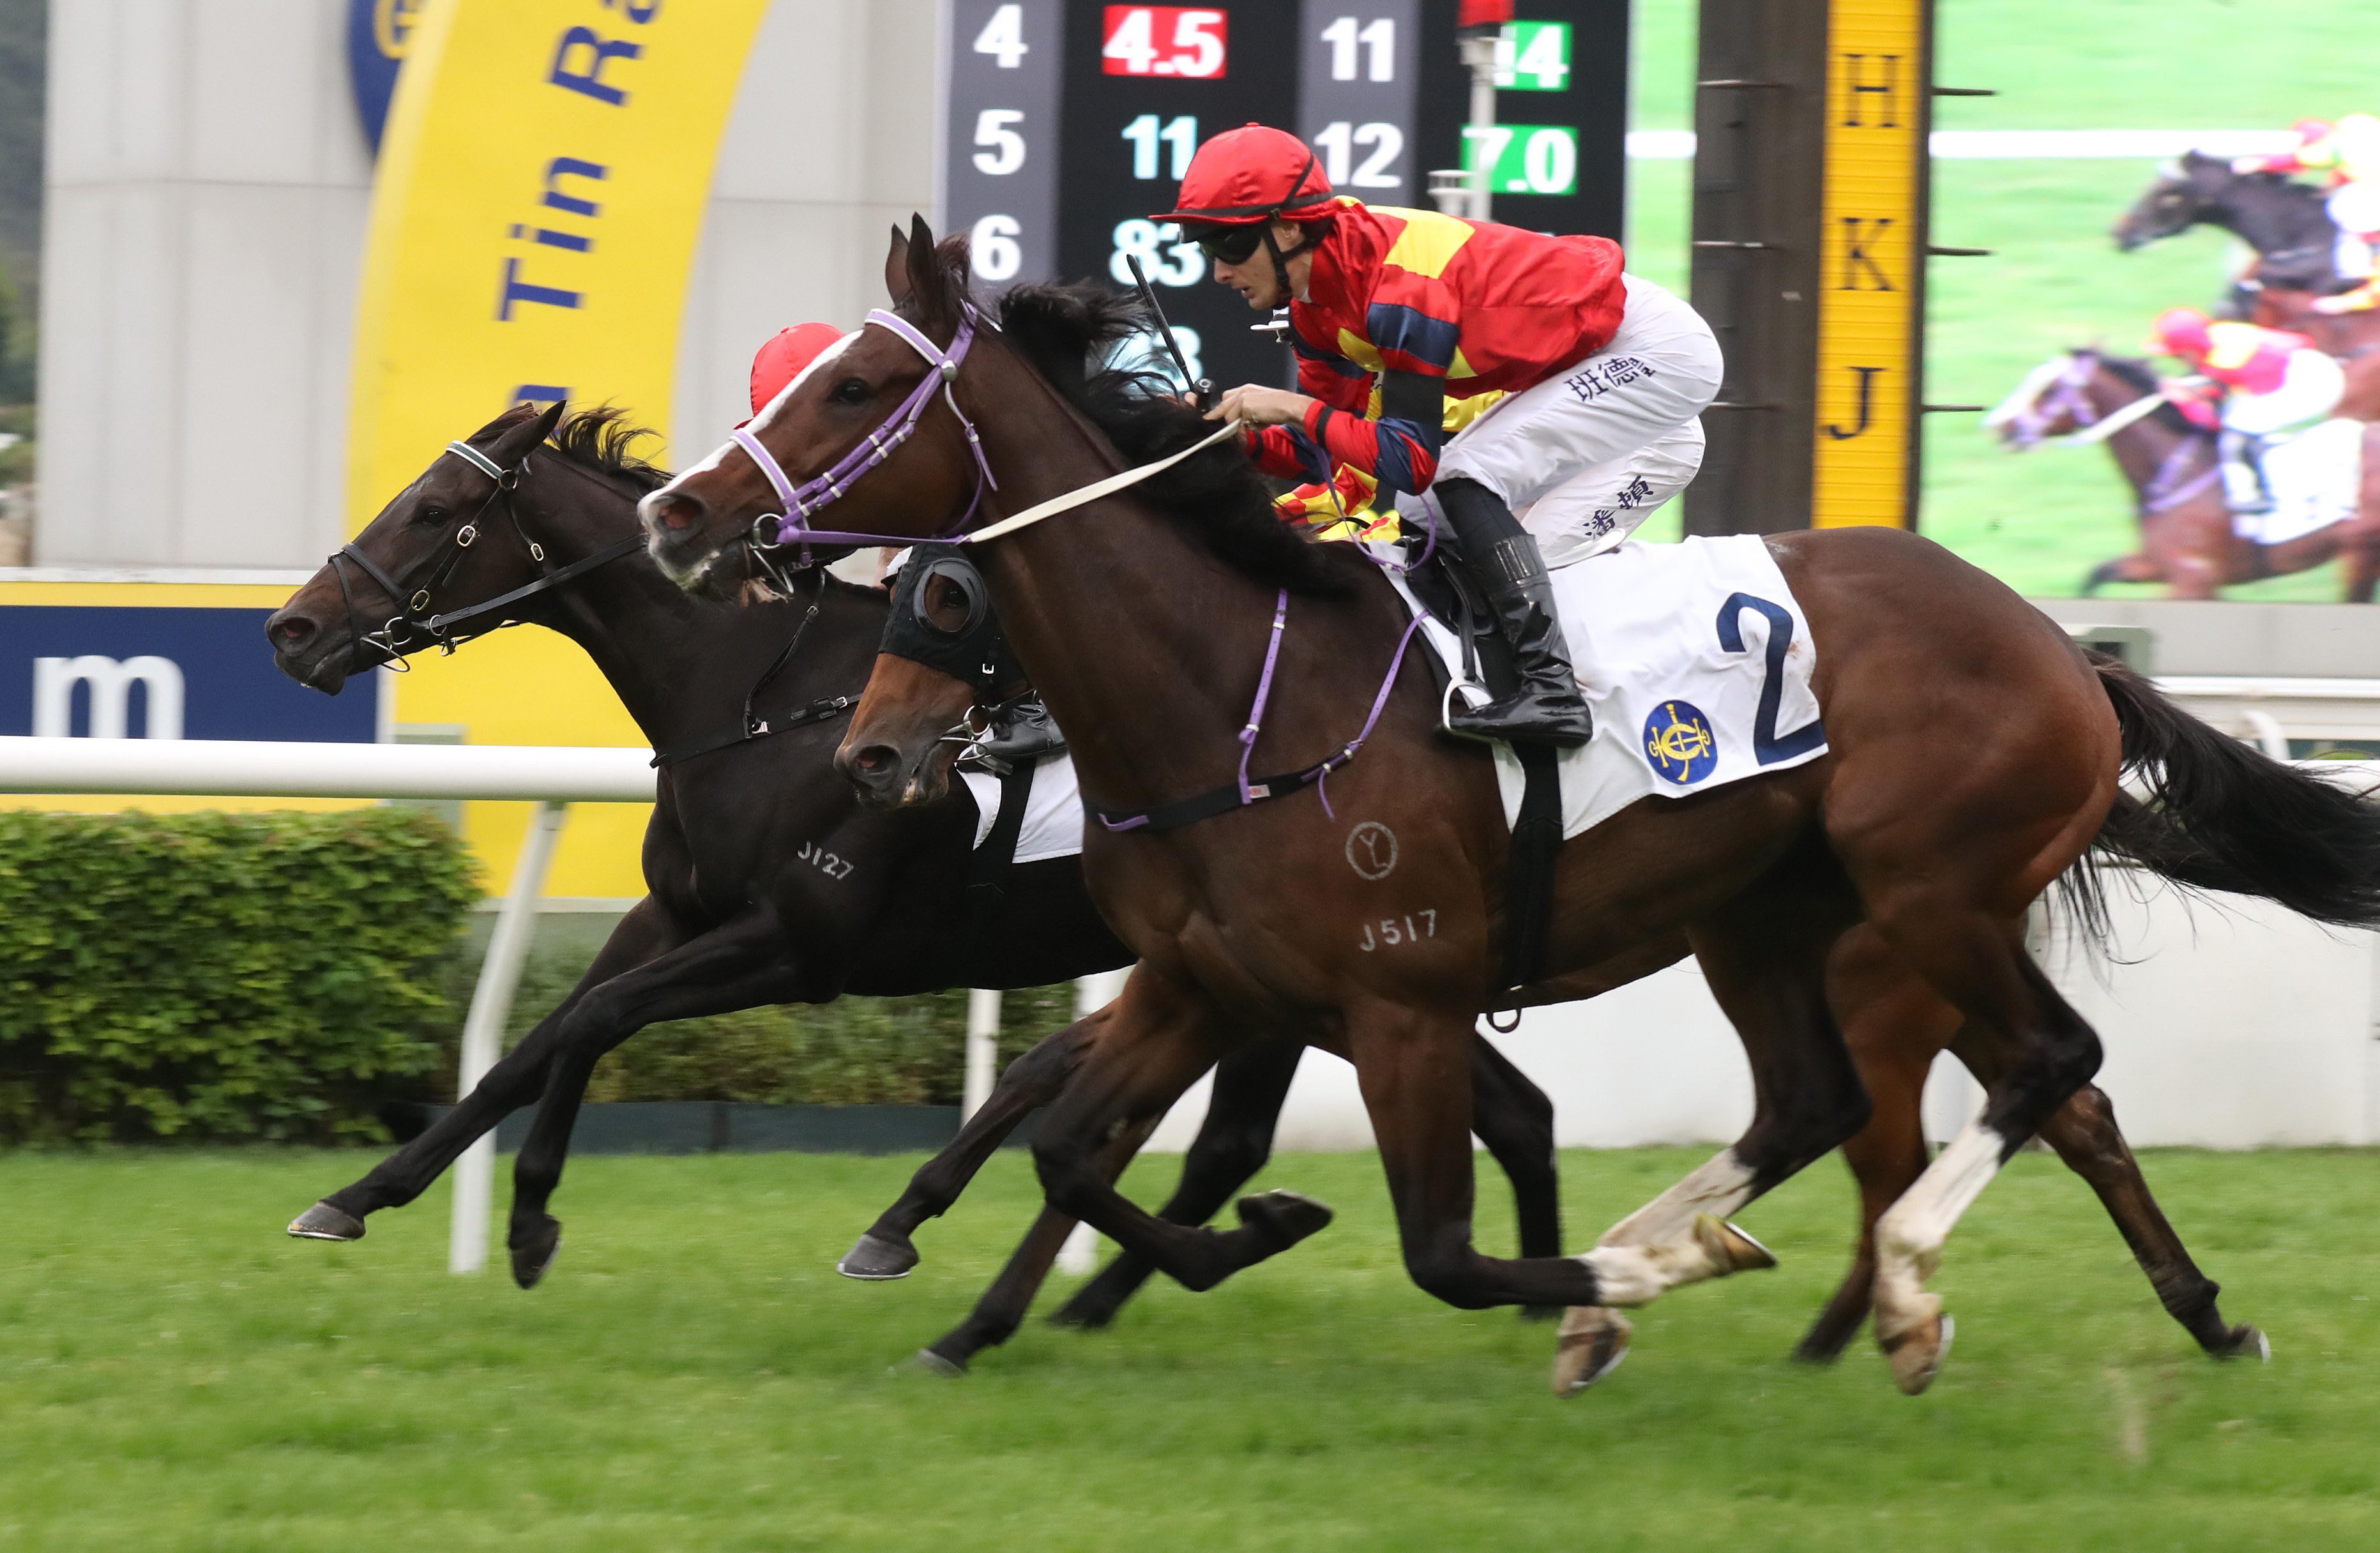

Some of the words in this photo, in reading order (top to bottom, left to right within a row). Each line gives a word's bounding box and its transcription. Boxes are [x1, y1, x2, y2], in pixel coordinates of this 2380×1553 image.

[973, 4, 1029, 68] 4
[1102, 10, 1225, 77] 4.5
[1320, 15, 1395, 82] 11
[973, 109, 1026, 176] 5
[1121, 114, 1198, 180] 11
[1313, 121, 1404, 188] 12
[1461, 127, 1577, 193] 7.0
[494, 156, 610, 322] Tin
[970, 215, 1022, 281] 6
[1109, 218, 1206, 287] 83
[1717, 592, 1828, 766] 2
[798, 840, 854, 881] J127
[1360, 909, 1436, 952] J517
